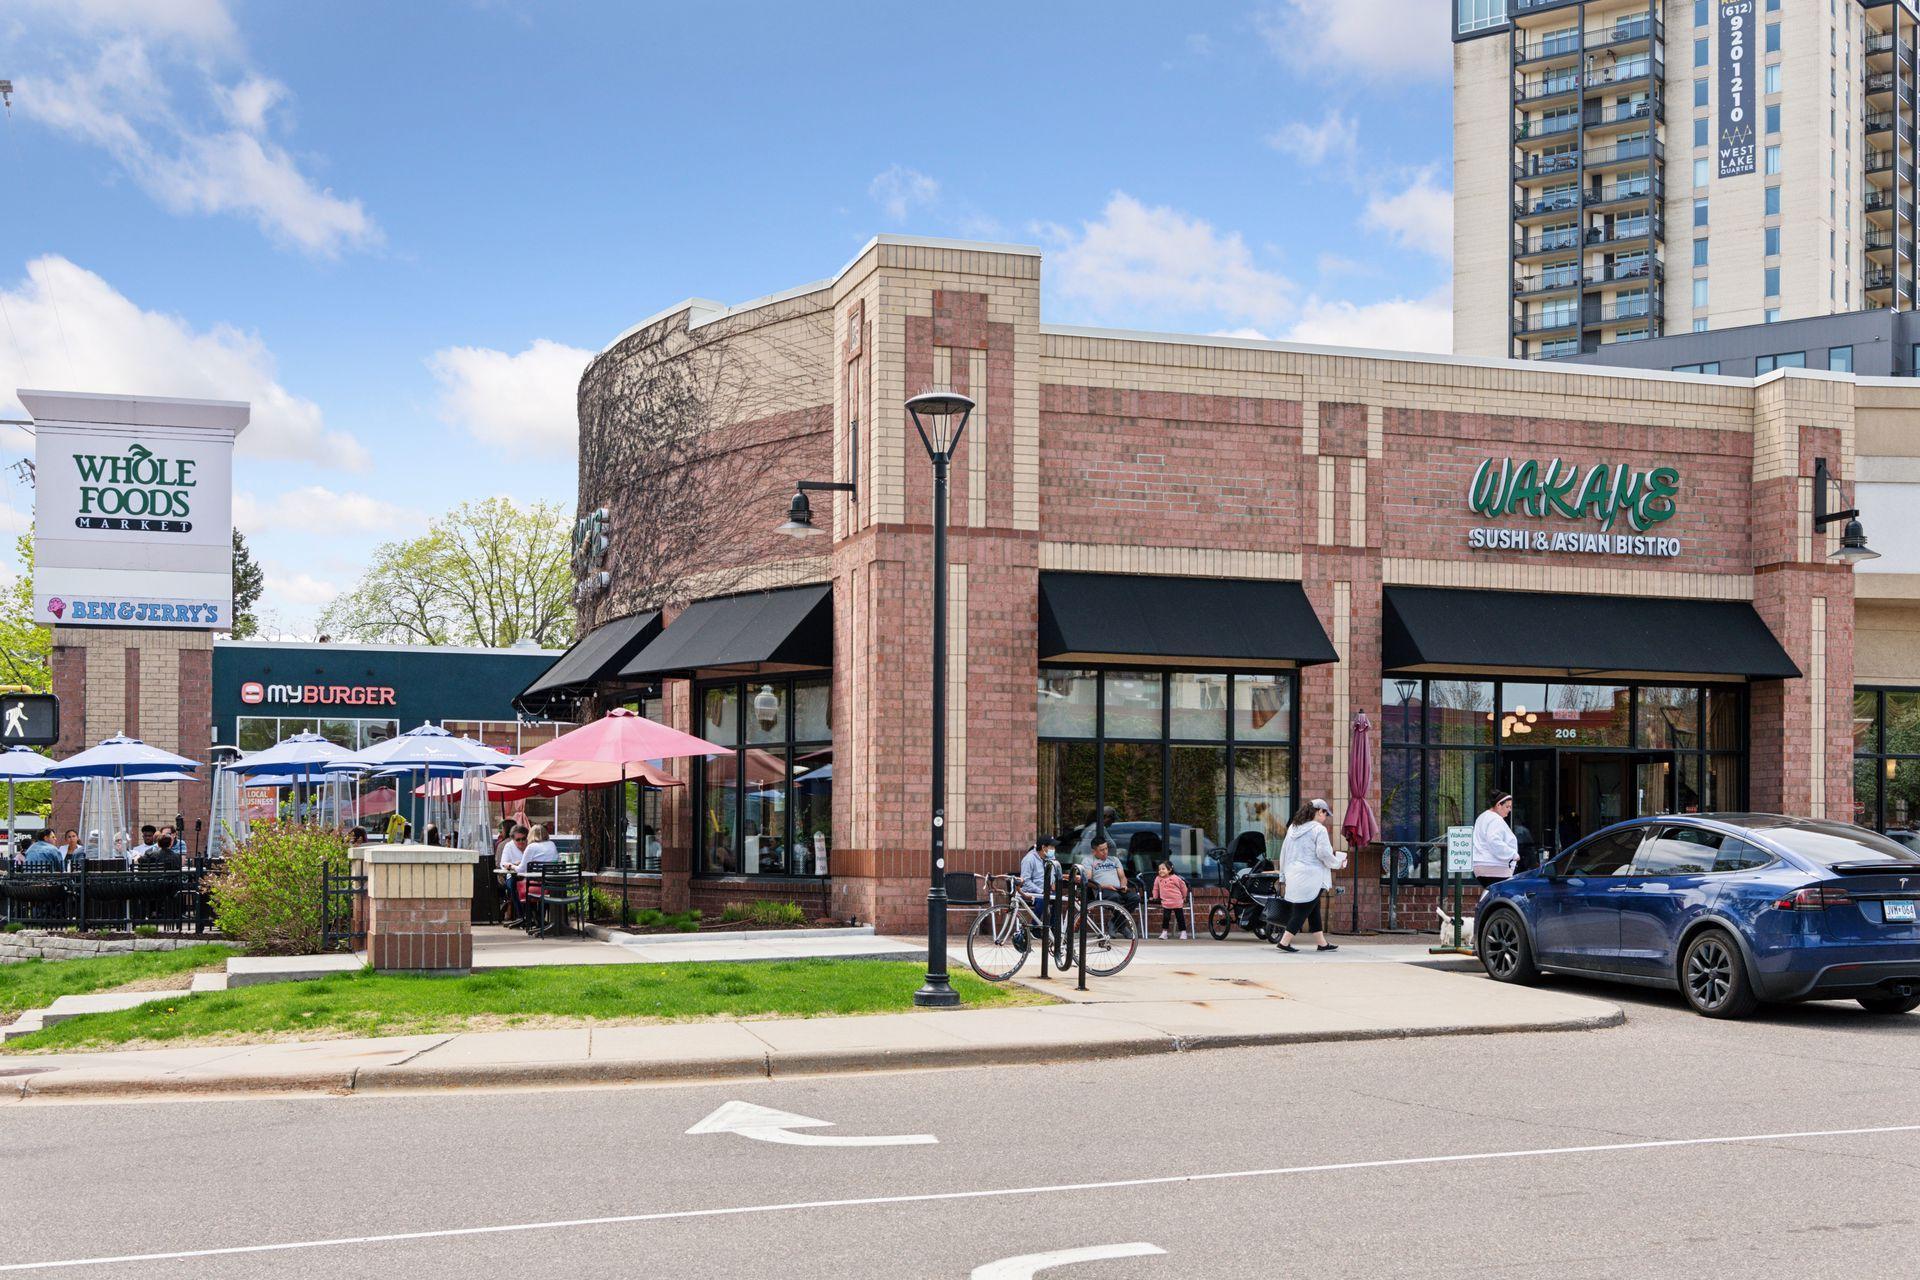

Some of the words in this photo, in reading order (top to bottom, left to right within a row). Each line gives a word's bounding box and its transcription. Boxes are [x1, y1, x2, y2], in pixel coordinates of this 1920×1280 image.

[1722, 0, 1752, 18] (612)
[1720, 144, 1754, 158] WEST
[1721, 154, 1753, 169] LAKE
[1720, 164, 1754, 175] QUARTER
[73, 443, 197, 487] WHOLE
[1469, 457, 1680, 532] WAKAME
[79, 486, 190, 518] FOODS
[79, 518, 189, 532] MARKET
[1469, 528, 1529, 550] SUSHI
[1533, 532, 1549, 550] &
[1551, 533, 1610, 553] ASIAN
[1613, 535, 1681, 557] BISTRO
[1555, 728, 1577, 738] 206
[247, 790, 268, 798] LOCAL
[247, 797, 274, 806] USINESS
